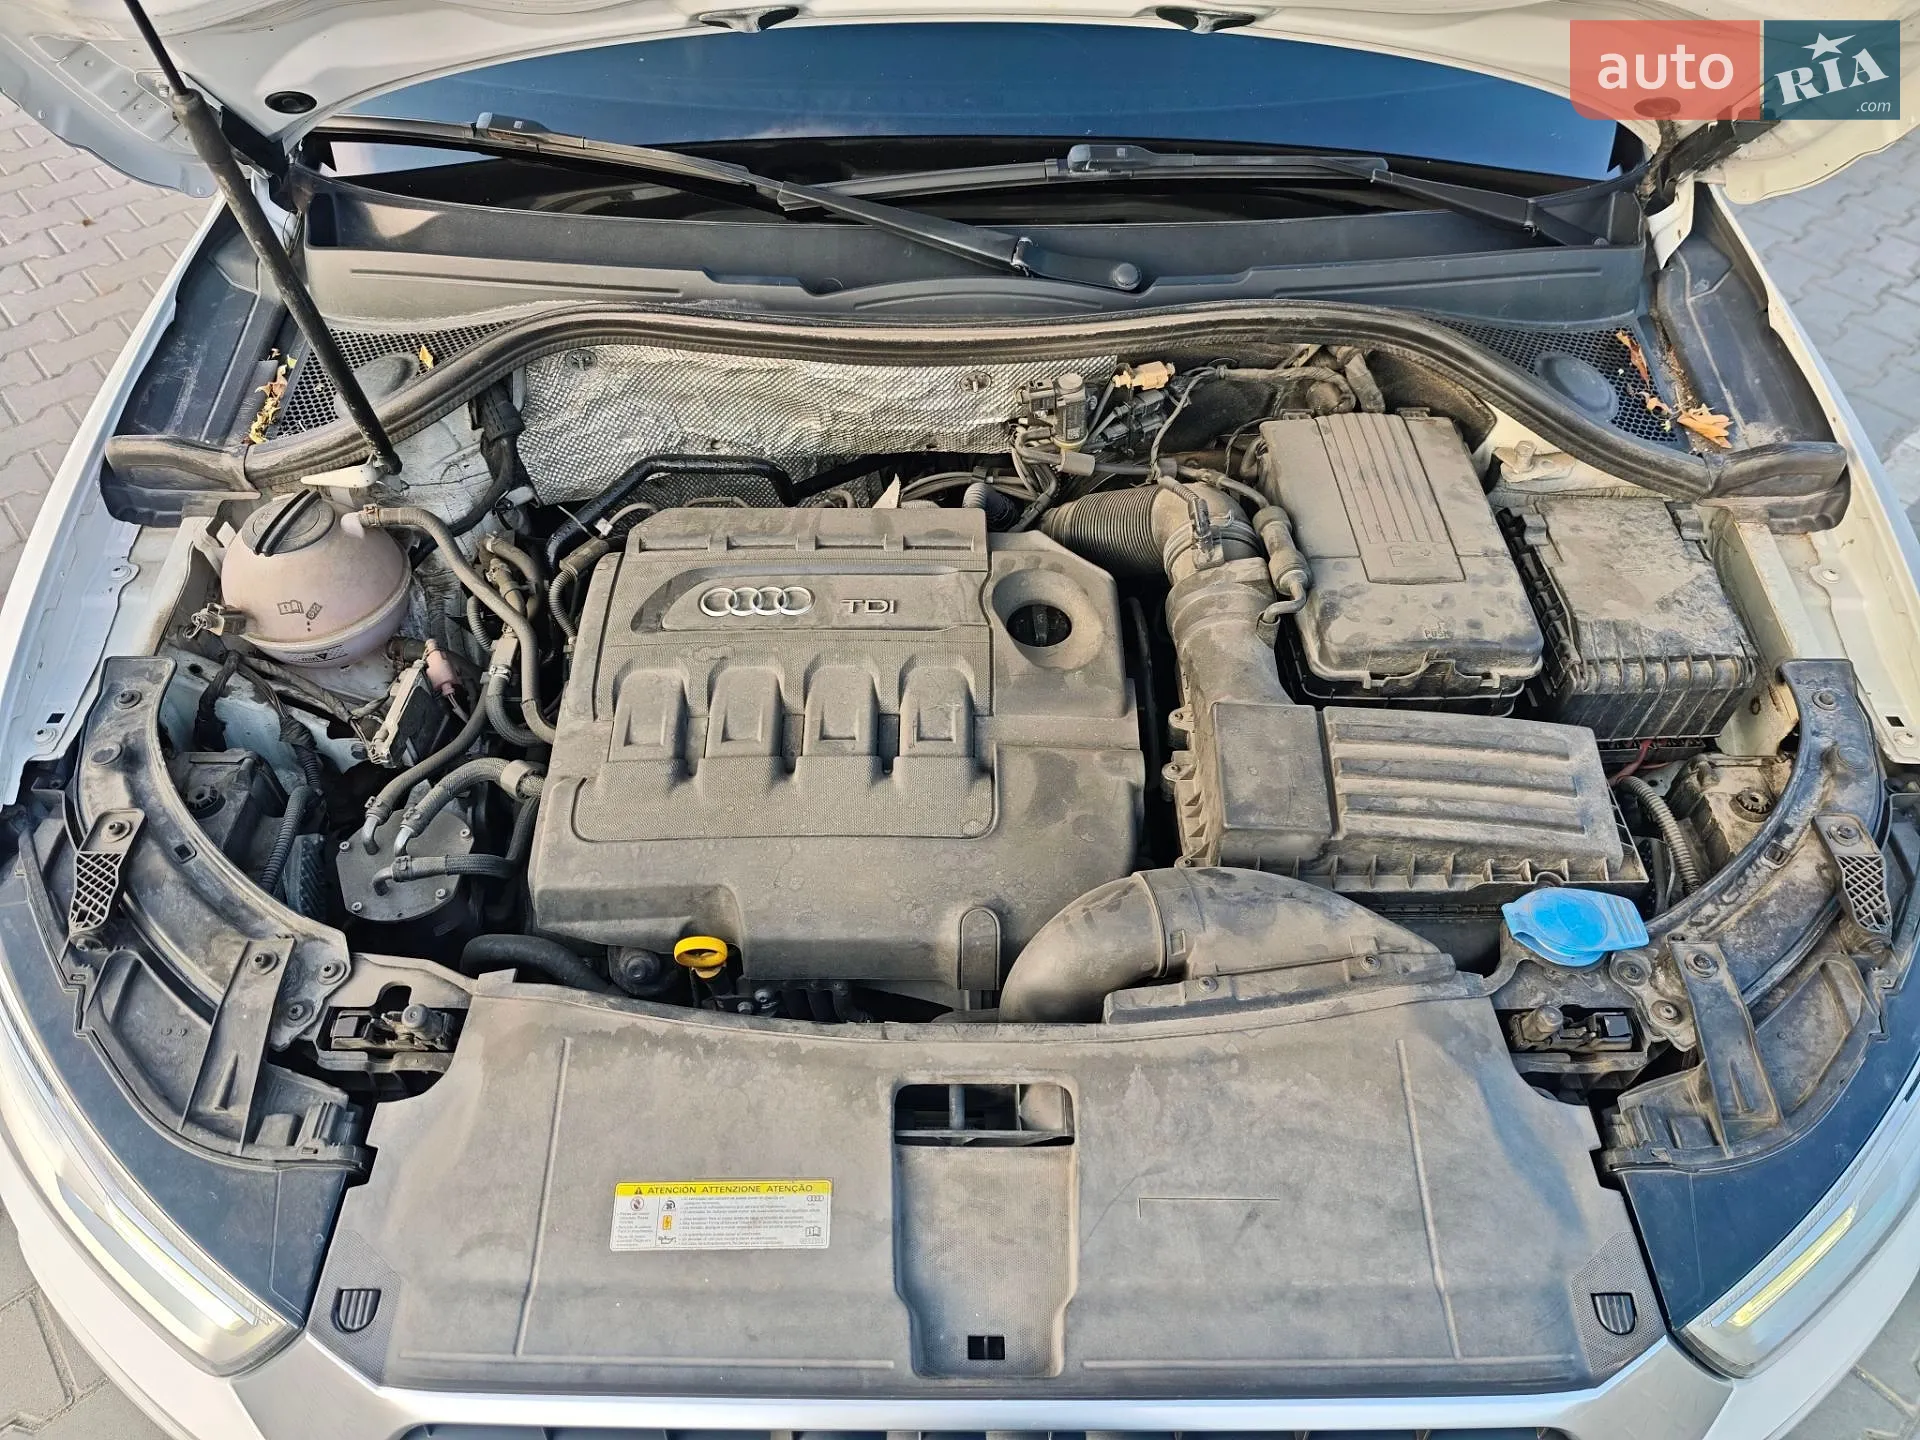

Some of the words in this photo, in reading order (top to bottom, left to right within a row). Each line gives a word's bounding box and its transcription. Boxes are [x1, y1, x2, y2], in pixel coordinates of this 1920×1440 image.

[841, 598, 897, 614] TDI
[701, 1185, 761, 1194] ATTENZIONE
[766, 1183, 813, 1193] ATENÇÃO
